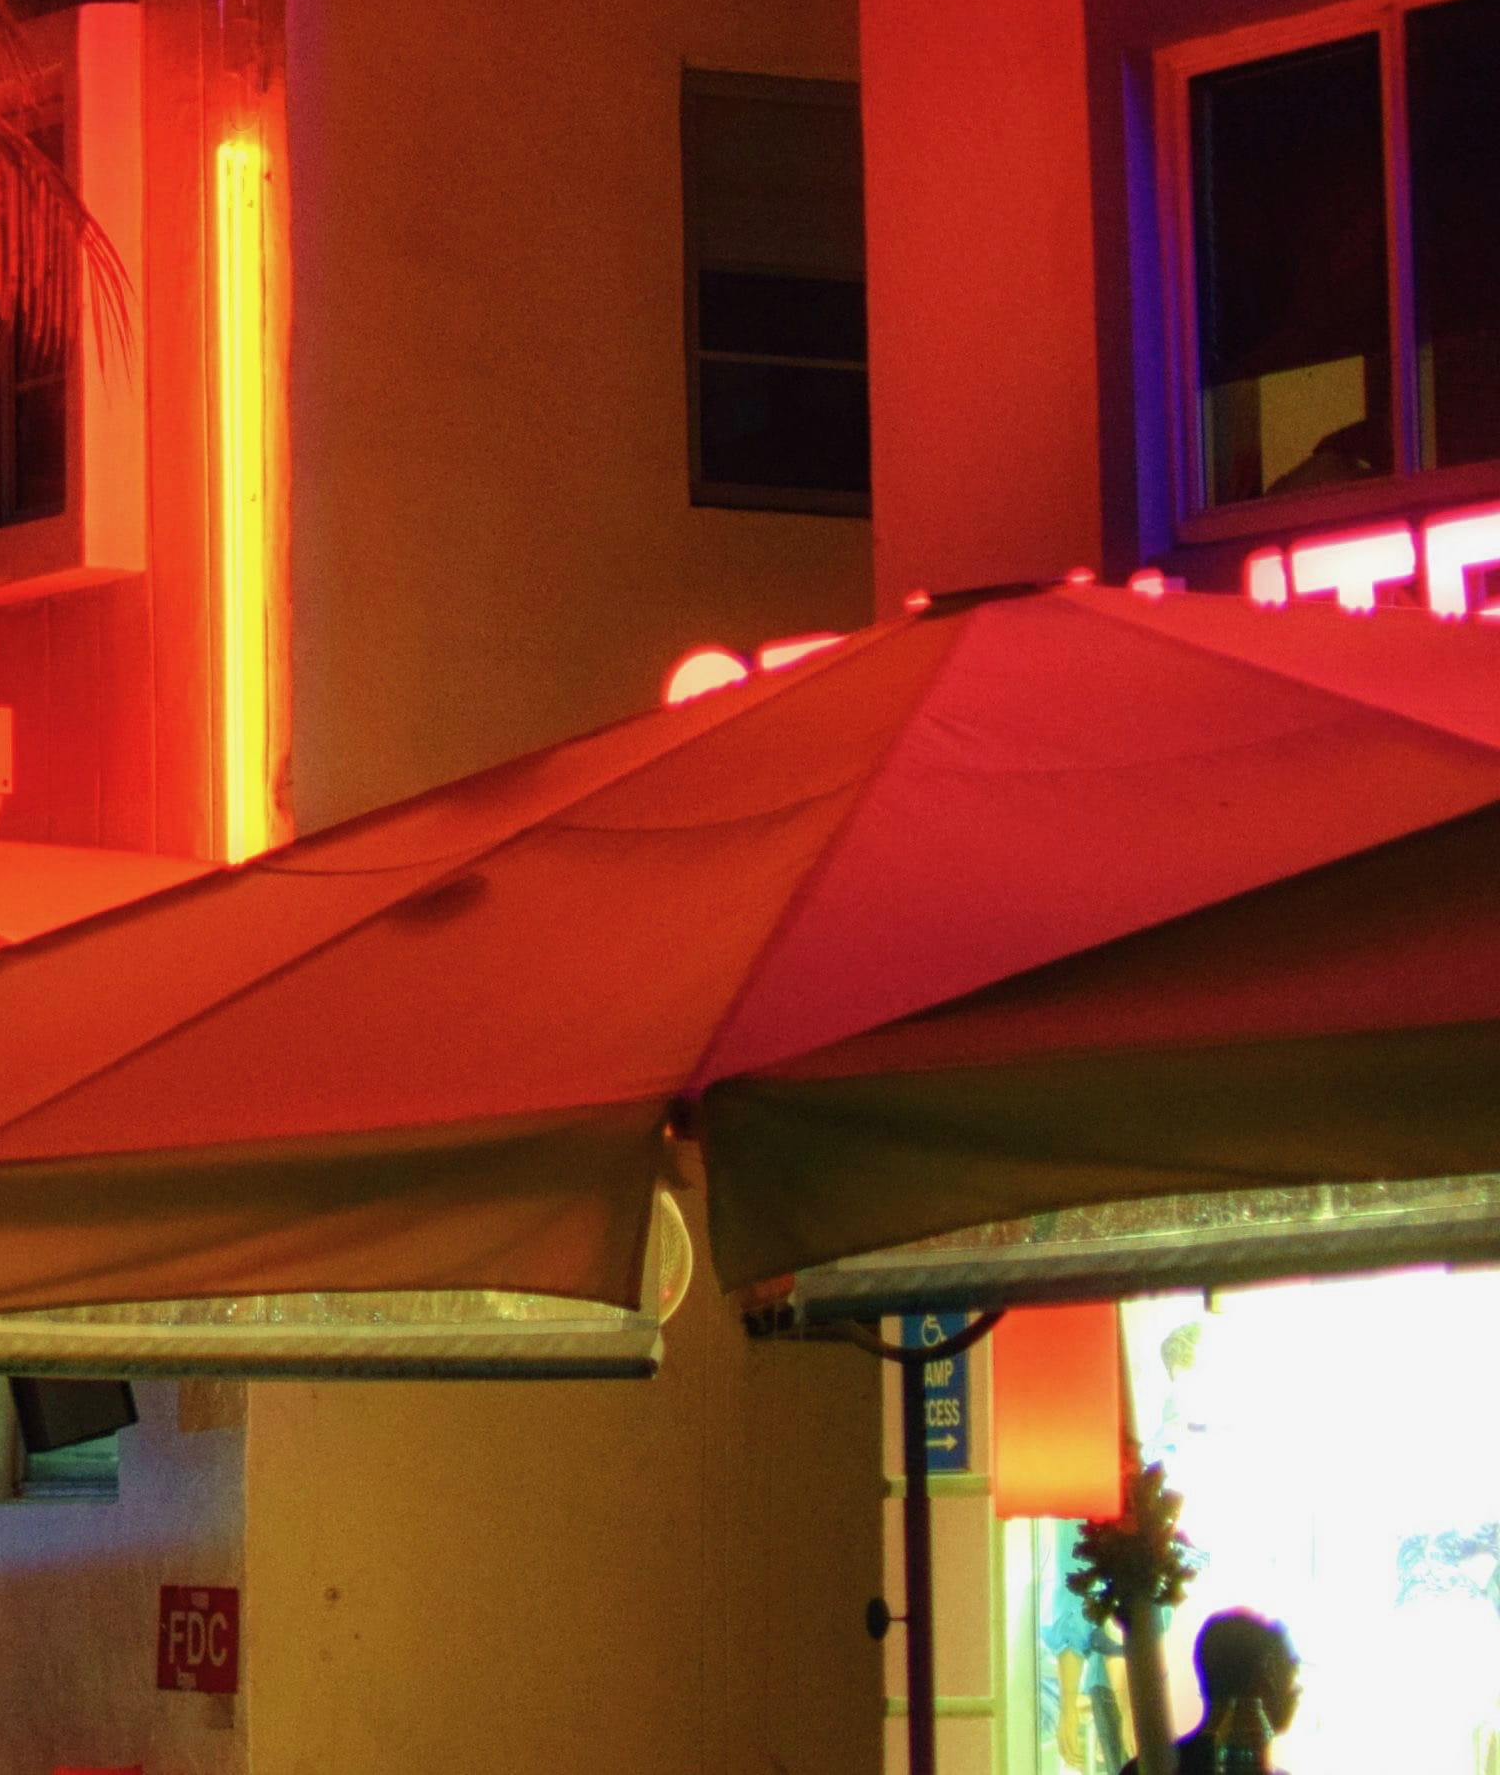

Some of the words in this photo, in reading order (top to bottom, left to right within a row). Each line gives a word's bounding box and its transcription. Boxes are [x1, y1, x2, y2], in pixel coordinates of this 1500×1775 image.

[925, 1362, 953, 1387] AMP
[926, 1399, 960, 1426] CESS
[169, 1610, 228, 1667] FDC
